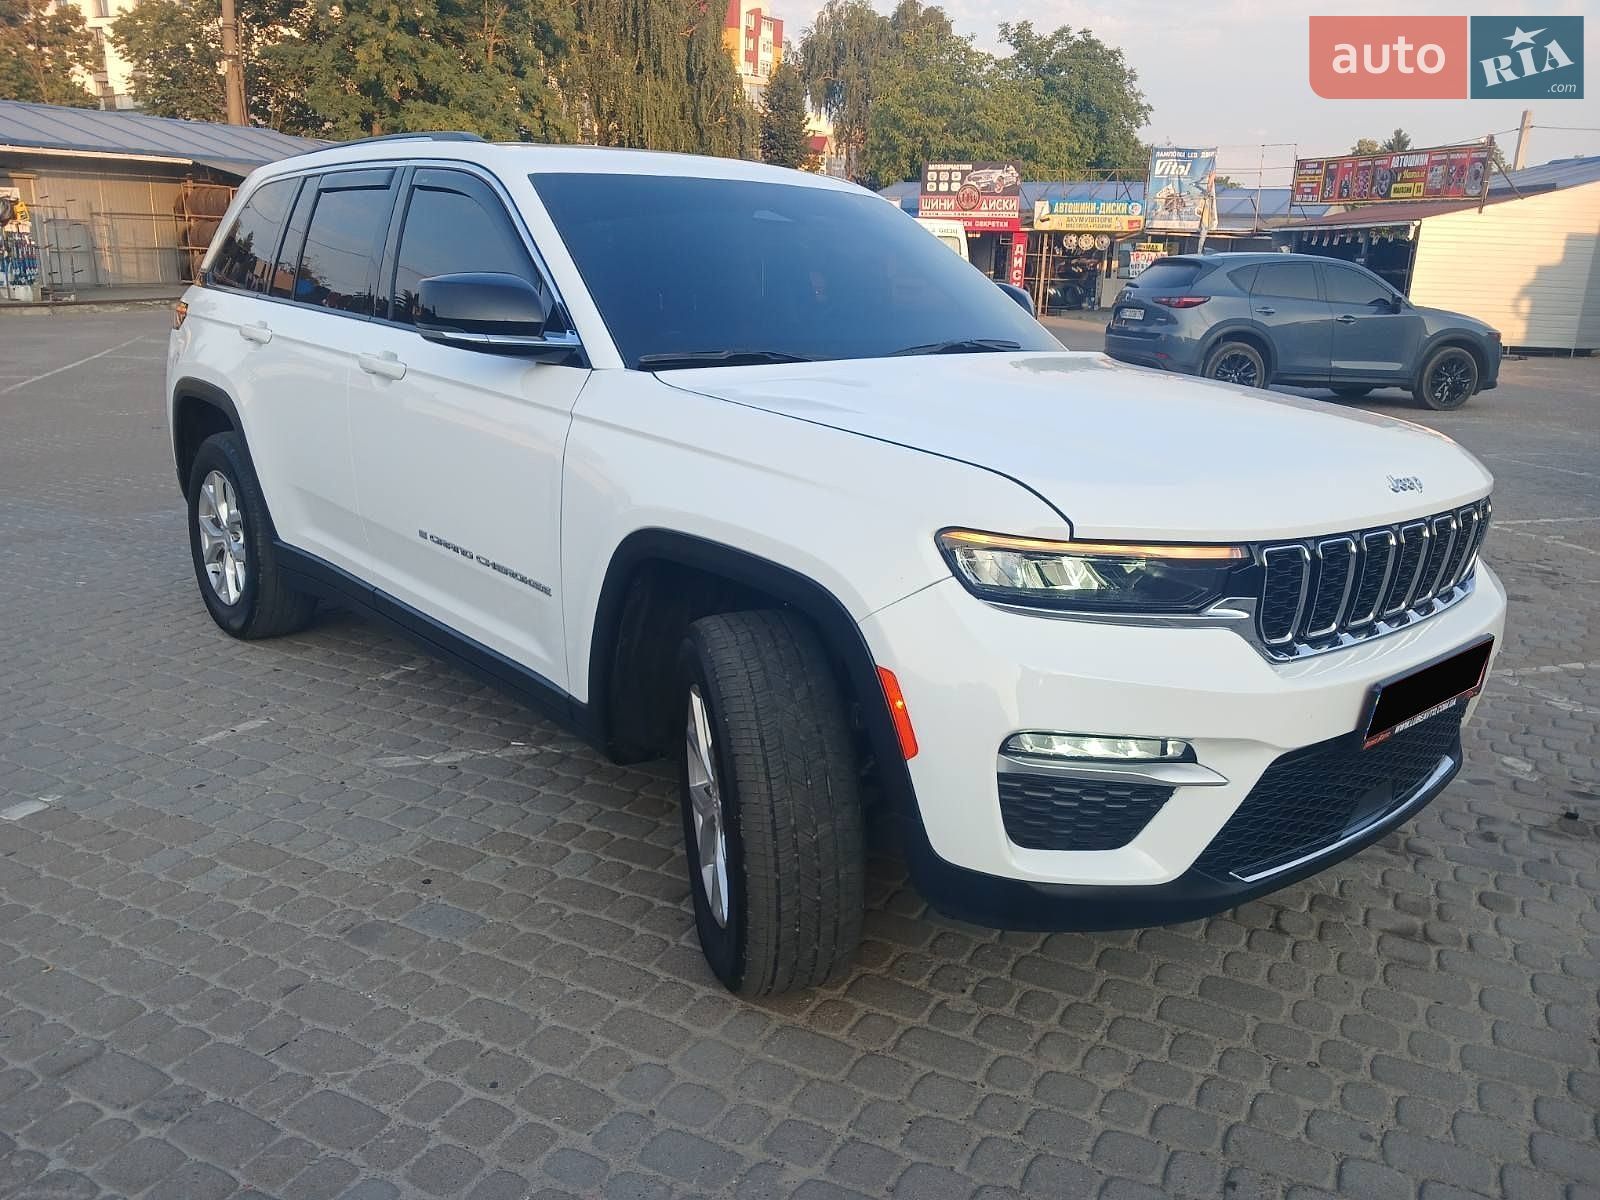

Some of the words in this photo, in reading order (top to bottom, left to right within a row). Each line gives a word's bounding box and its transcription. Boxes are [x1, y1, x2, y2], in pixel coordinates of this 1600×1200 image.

[922, 199, 955, 210] ШИНИ
[980, 199, 1017, 211] ДИСКИ
[1386, 474, 1423, 494] Jeep
